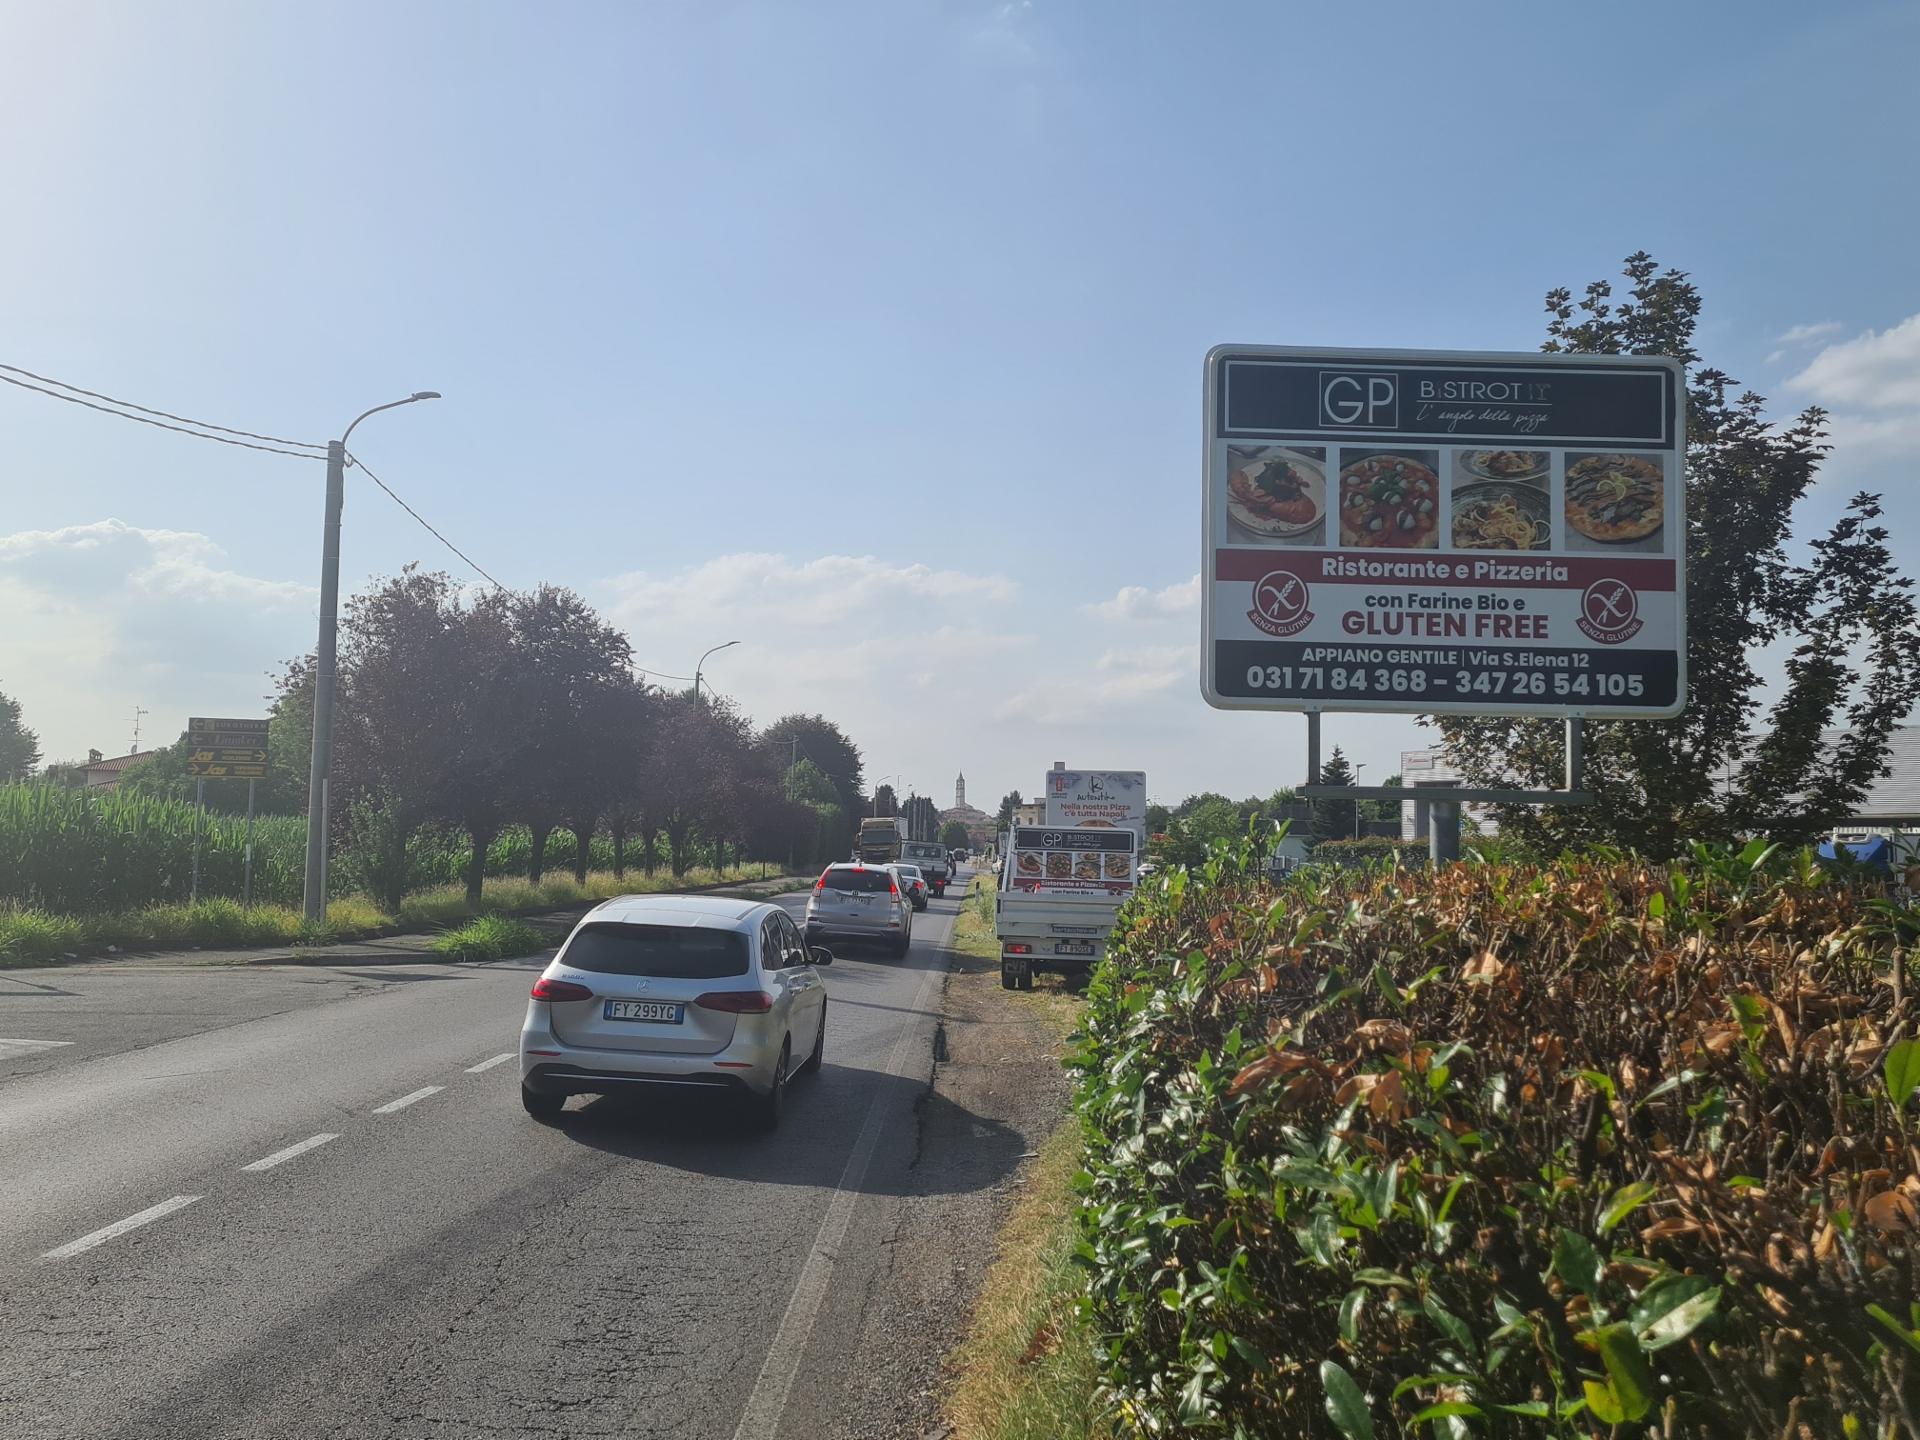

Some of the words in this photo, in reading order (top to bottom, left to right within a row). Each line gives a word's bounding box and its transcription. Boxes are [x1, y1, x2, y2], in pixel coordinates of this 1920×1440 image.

[1324, 376, 1394, 424] GP
[1479, 408, 1512, 421] della
[1513, 412, 1549, 432] pizza
[1322, 557, 1450, 579] Ristorante
[1455, 563, 1469, 579] e
[1474, 561, 1569, 581] Pizzeria
[1365, 595, 1403, 608] con
[1408, 592, 1473, 610] Farine
[1478, 593, 1509, 611] Bio
[1513, 597, 1526, 611] e
[1251, 613, 1275, 633] SENZA
[1278, 614, 1312, 633] GLUTINE
[1342, 610, 1467, 637] GLUTEN
[1475, 614, 1549, 639] FREE
[1580, 621, 1605, 640] SENZA
[1607, 622, 1640, 641] GLUTINE
[1302, 648, 1383, 663] APPIANO
[1387, 650, 1457, 664] GENTILE
[1469, 651, 1499, 666] Via
[1503, 652, 1569, 667] S.Elena
[1571, 653, 1590, 668] 12
[1246, 666, 1292, 688] 031
[1299, 667, 1324, 689] 71
[1331, 668, 1368, 691] 84
[1374, 669, 1427, 692] 368
[1455, 671, 1507, 694] 347
[1512, 672, 1546, 695] 26
[1554, 673, 1590, 695] 54
[1596, 674, 1644, 697] 105
[1110, 803, 1131, 811] Pizza
[1042, 833, 1062, 846] GP
[1041, 880, 1075, 888] Ristorante
[613, 1003, 629, 1017] FY
[633, 1003, 675, 1019] 299YG
